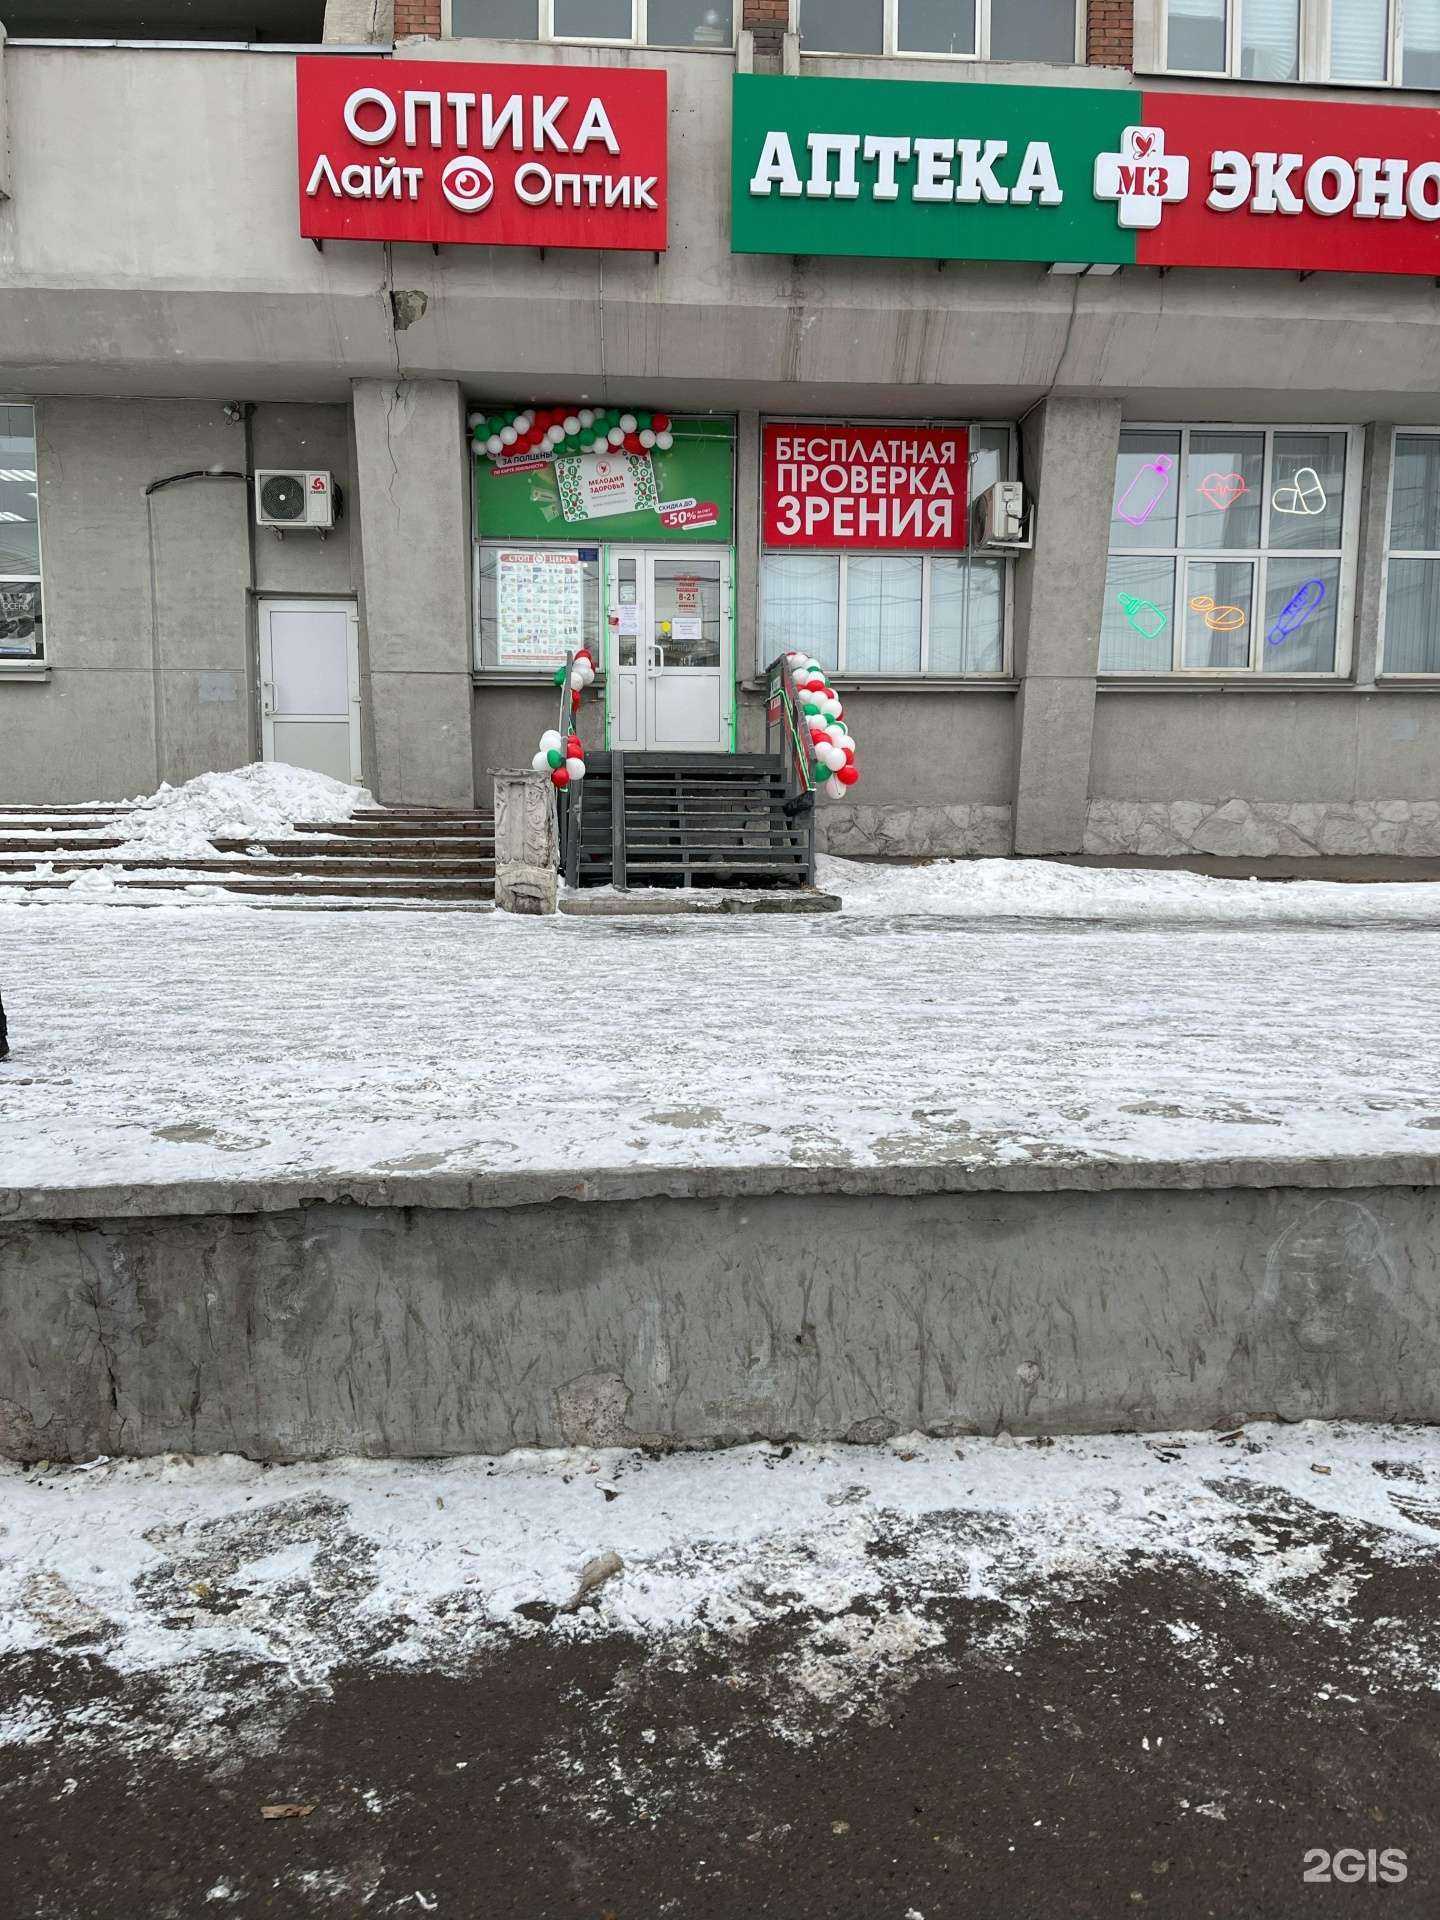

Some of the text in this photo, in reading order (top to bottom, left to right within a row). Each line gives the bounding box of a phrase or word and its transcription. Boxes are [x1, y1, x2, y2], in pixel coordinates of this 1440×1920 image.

[343, 87, 621, 155] ОПТИКА
[306, 154, 659, 209] Лайт Оптик
[749, 131, 1063, 206] АПТЕКА
[1206, 150, 1440, 222] ЭКОНО
[776, 437, 956, 464] БЕСПЛАТНАЯ
[588, 475, 624, 486] МЕЛОДИЯ
[590, 482, 625, 493] ЗДОРОВЬЯ
[777, 463, 954, 495] ПРОВЕРКА
[776, 495, 952, 537] ЗРЕНИЯ
